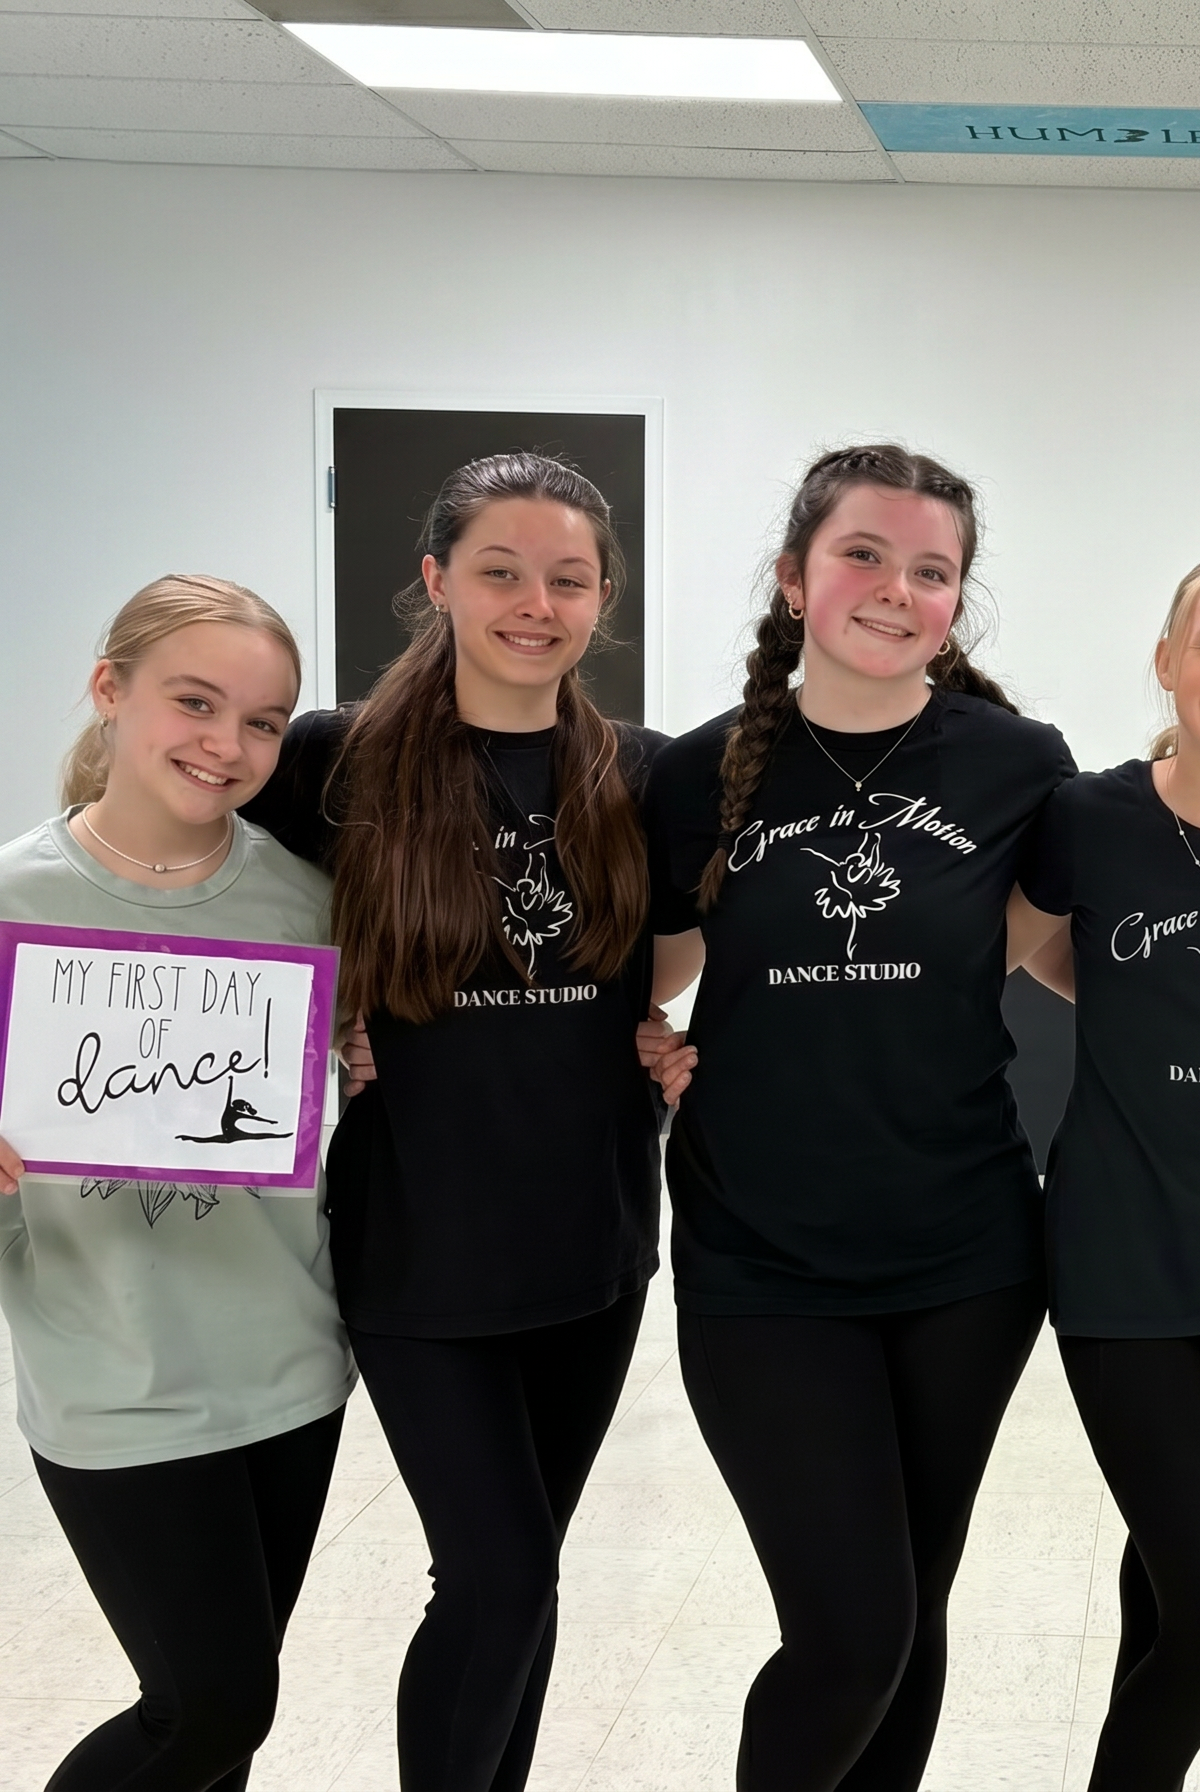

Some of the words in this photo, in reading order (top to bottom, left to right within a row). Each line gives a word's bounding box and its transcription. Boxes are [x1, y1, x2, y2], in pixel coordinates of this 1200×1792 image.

[494, 825, 517, 849] in
[727, 814, 820, 872] Grace
[829, 804, 855, 828] in
[858, 792, 977, 854] Motion
[1111, 910, 1199, 962] Grace
[52, 958, 94, 1006] MY
[108, 962, 187, 1011] FIRST
[202, 968, 261, 1016] DAY
[453, 989, 520, 1008] DANCE
[524, 984, 598, 1004] STUDIO
[768, 964, 839, 985] DANCE
[844, 962, 921, 981] STUDIO
[57, 998, 272, 1114] dance!
[139, 1018, 172, 1059] OF
